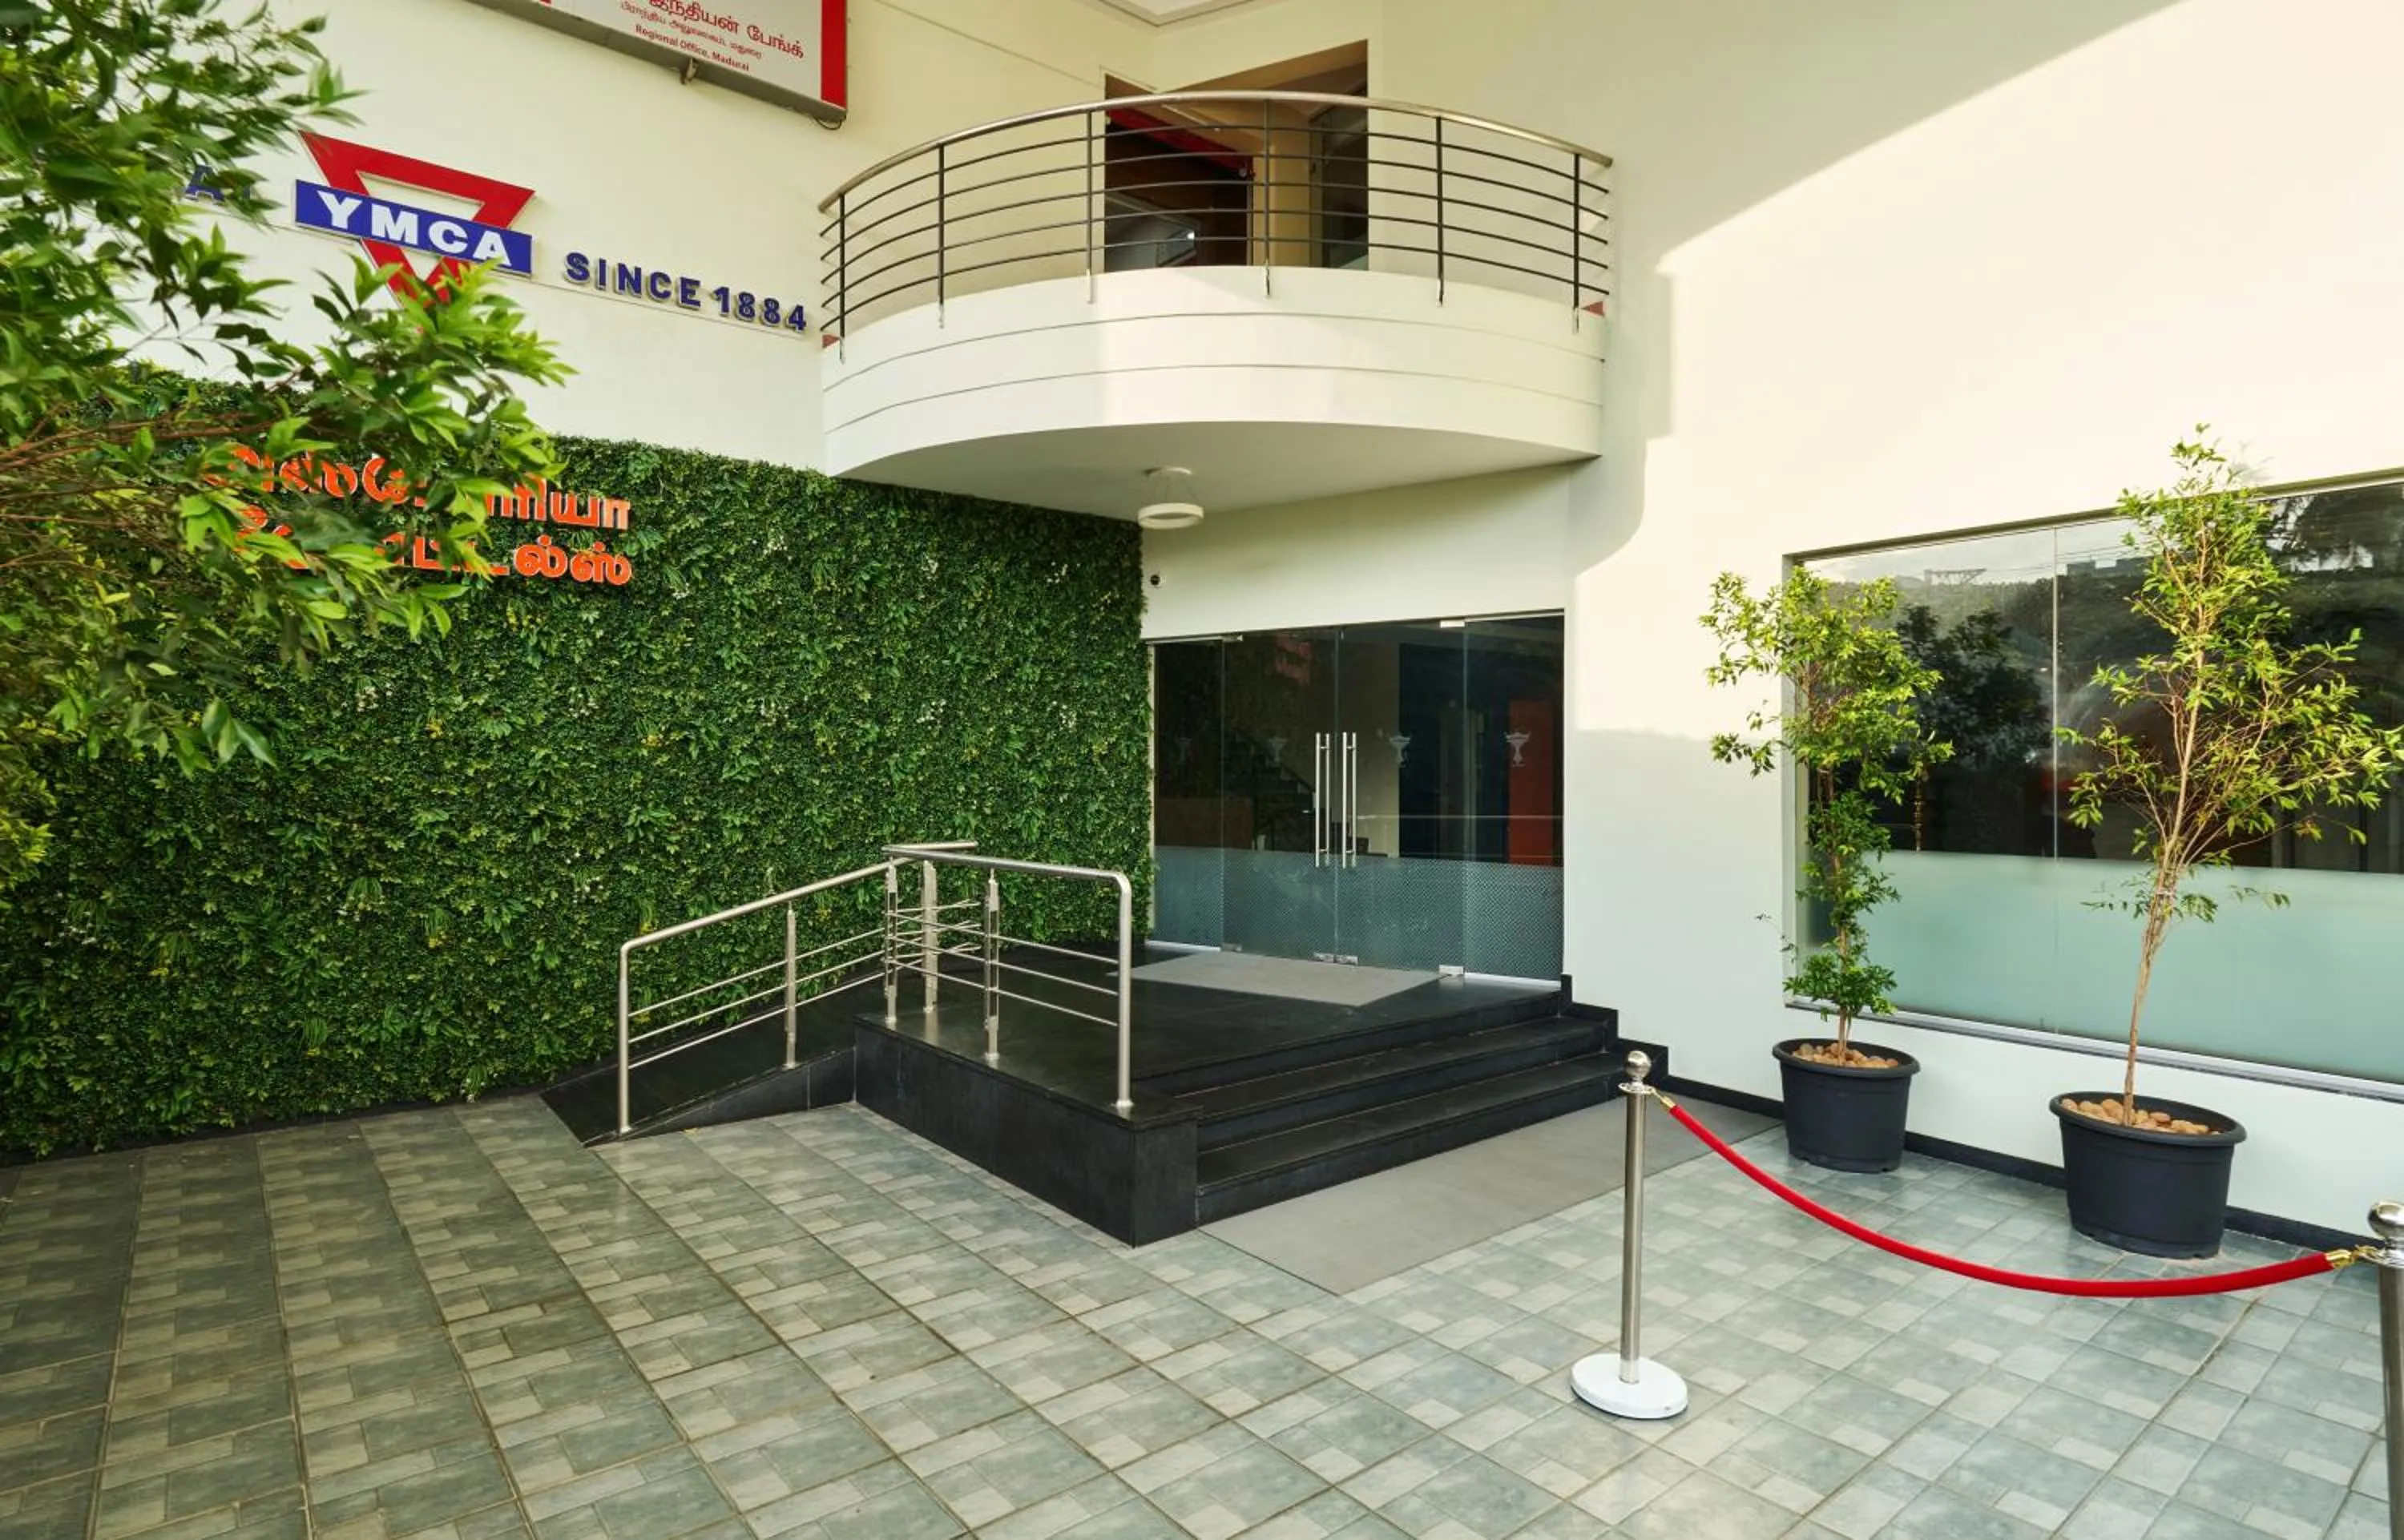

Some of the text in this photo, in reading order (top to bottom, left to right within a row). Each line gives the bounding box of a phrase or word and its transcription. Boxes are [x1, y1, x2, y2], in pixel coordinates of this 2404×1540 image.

[635, 24, 678, 46] Regional
[712, 50, 750, 71] Madurai
[746, 25, 804, 58] பேங்க்
[317, 189, 513, 268] YMCA
[564, 252, 807, 333] SINCE 1884
